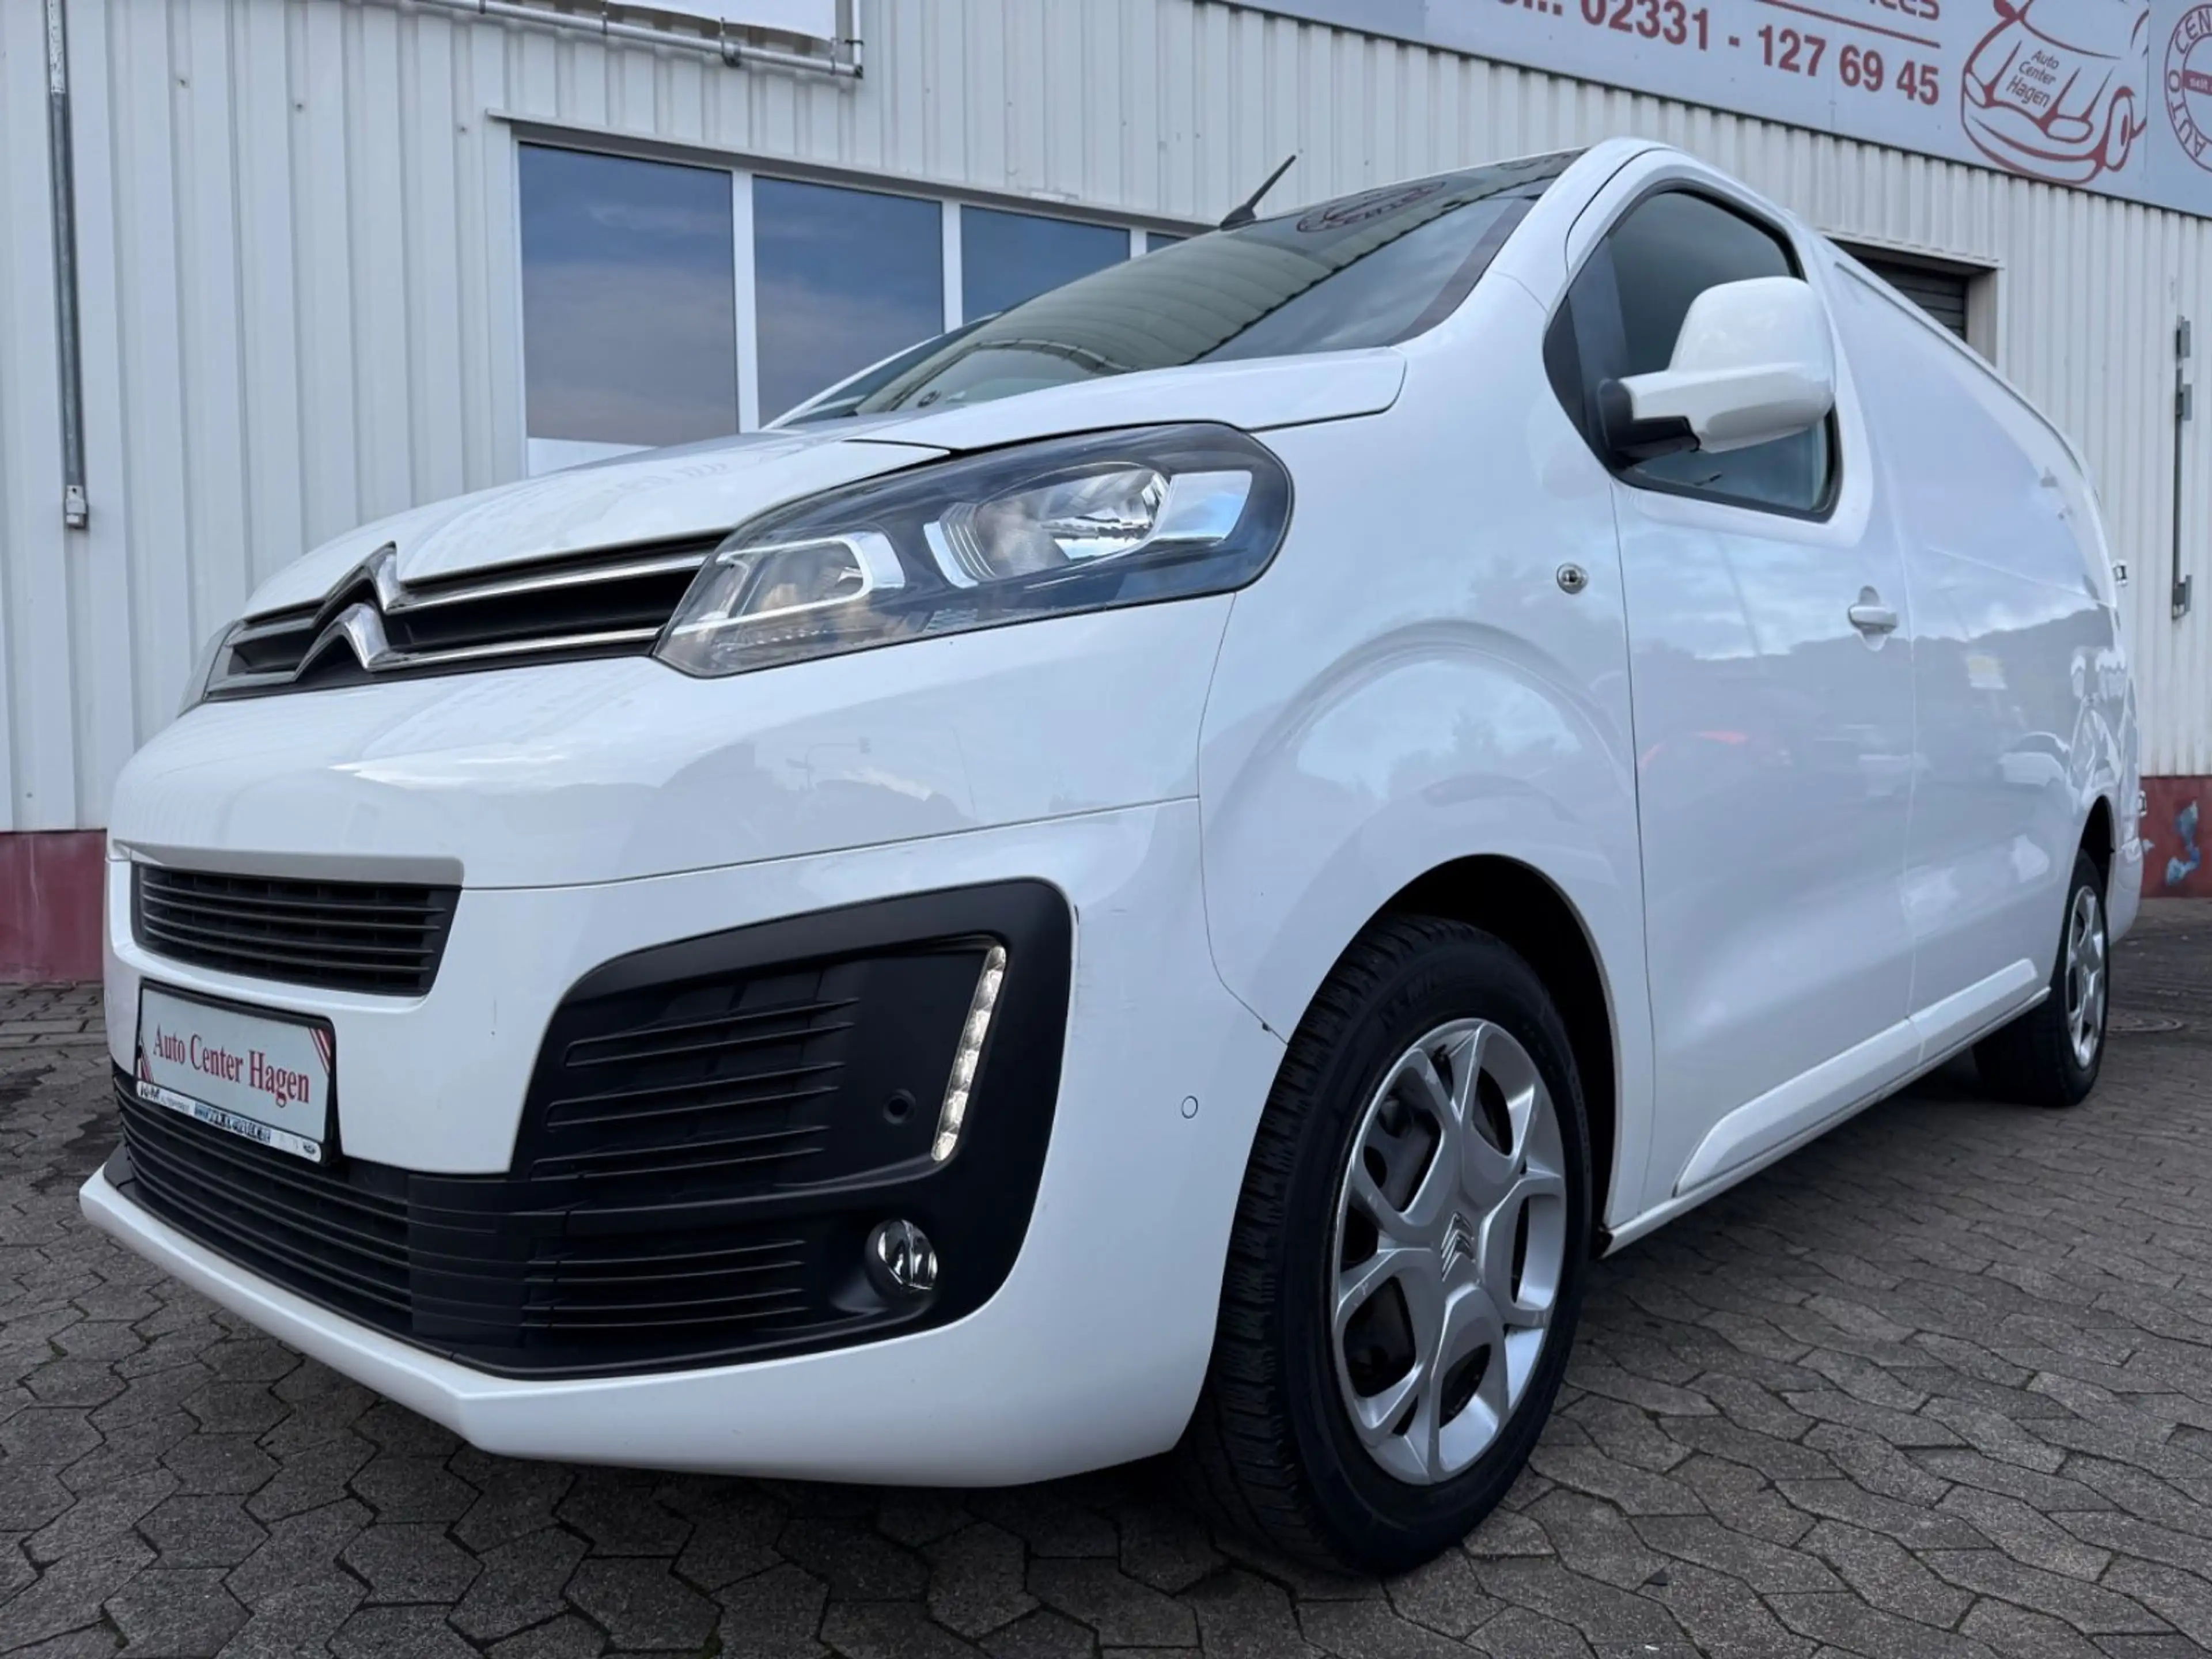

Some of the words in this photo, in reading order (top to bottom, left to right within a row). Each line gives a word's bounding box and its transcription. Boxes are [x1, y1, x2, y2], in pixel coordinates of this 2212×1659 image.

[1581, 0, 1708, 51] 02331
[1758, 25, 1826, 77] 127
[1839, 44, 1883, 92] 69
[1897, 60, 1939, 105] 45
[2018, 60, 2056, 85] Center
[2031, 48, 2059, 70] Auto
[2006, 74, 2051, 108] Hagen
[2168, 69, 2207, 157] AUTO
[153, 1023, 185, 1065] Auto
[190, 1033, 244, 1084] Center
[248, 1049, 310, 1108] Hagen
